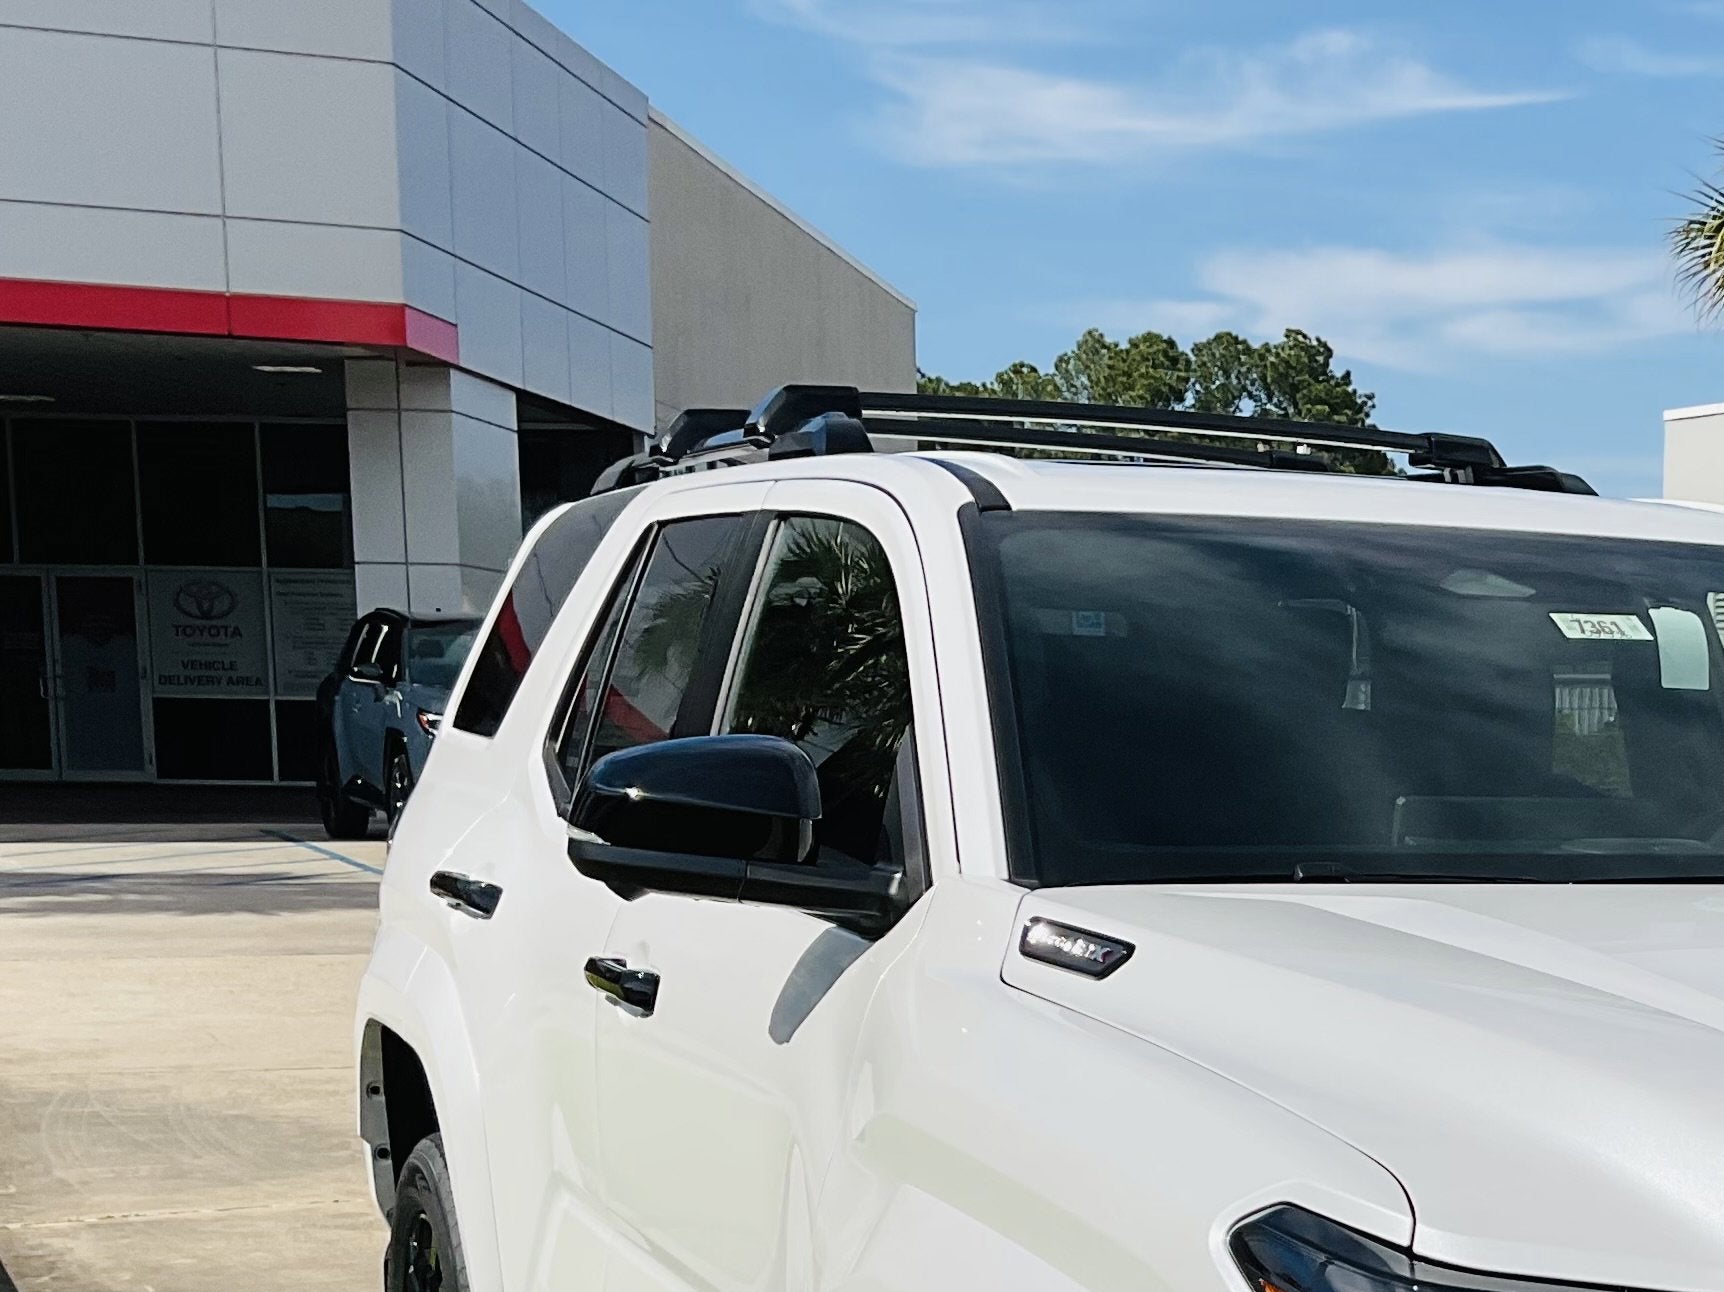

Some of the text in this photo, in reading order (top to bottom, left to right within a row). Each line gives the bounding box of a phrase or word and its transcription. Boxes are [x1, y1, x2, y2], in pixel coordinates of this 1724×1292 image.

[174, 624, 243, 638] TOYOTA
[182, 659, 238, 671] VEHICLE
[159, 674, 263, 686] DELIVERY AREA
